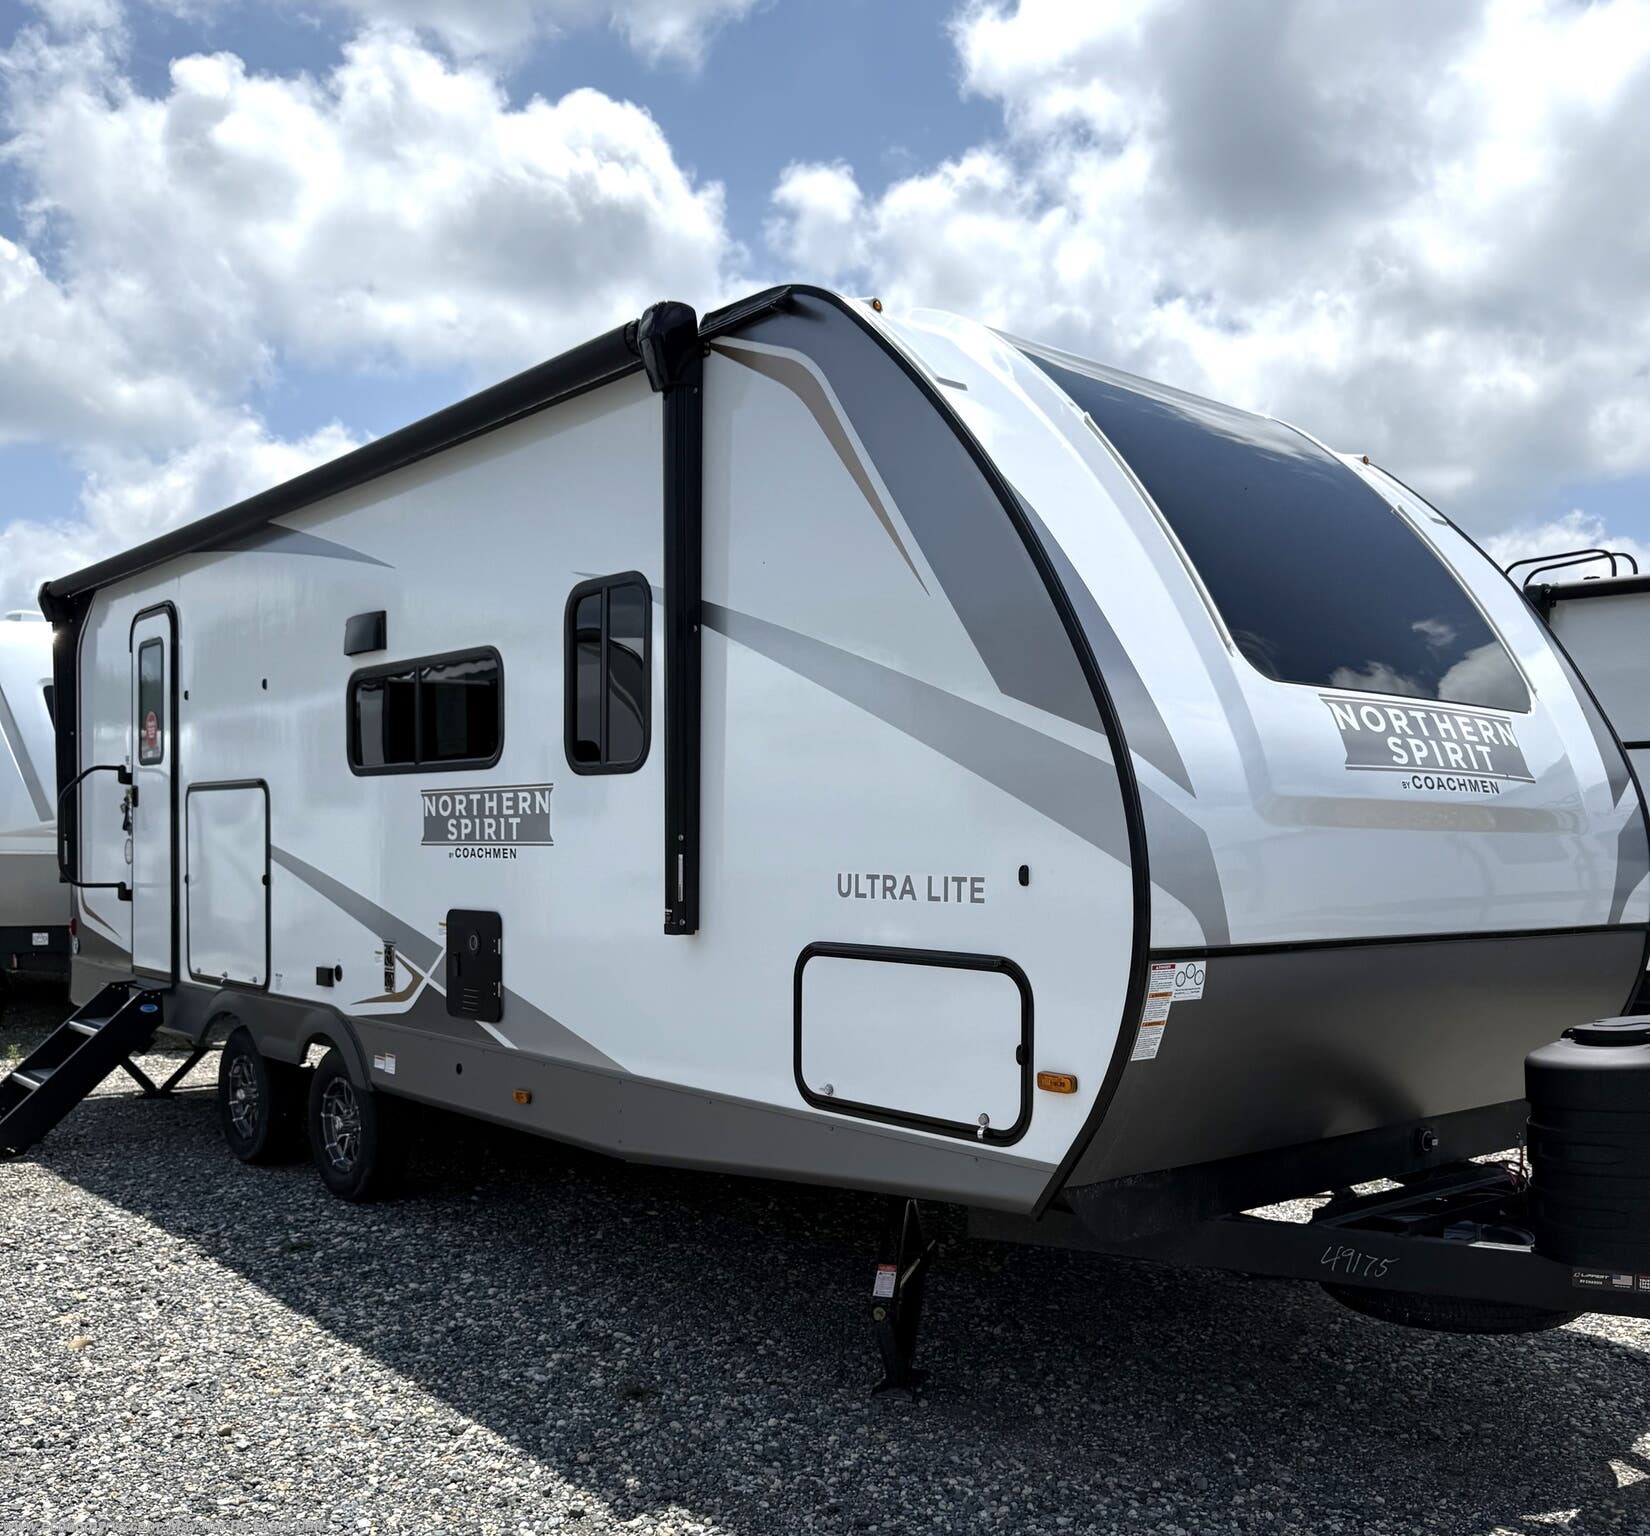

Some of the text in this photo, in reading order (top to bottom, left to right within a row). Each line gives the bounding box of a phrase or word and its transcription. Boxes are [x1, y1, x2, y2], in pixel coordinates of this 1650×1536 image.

[1327, 702, 1519, 748] NORTHERN
[1387, 736, 1494, 771] SPIRIT
[1411, 775, 1500, 794] COACHMEN
[423, 790, 550, 817] NORTHERN
[447, 817, 521, 841] SPIRIT
[454, 847, 517, 859] COACHMEN
[837, 873, 985, 904] ULTRA LITE
[1320, 1246, 1400, 1278] 49175
